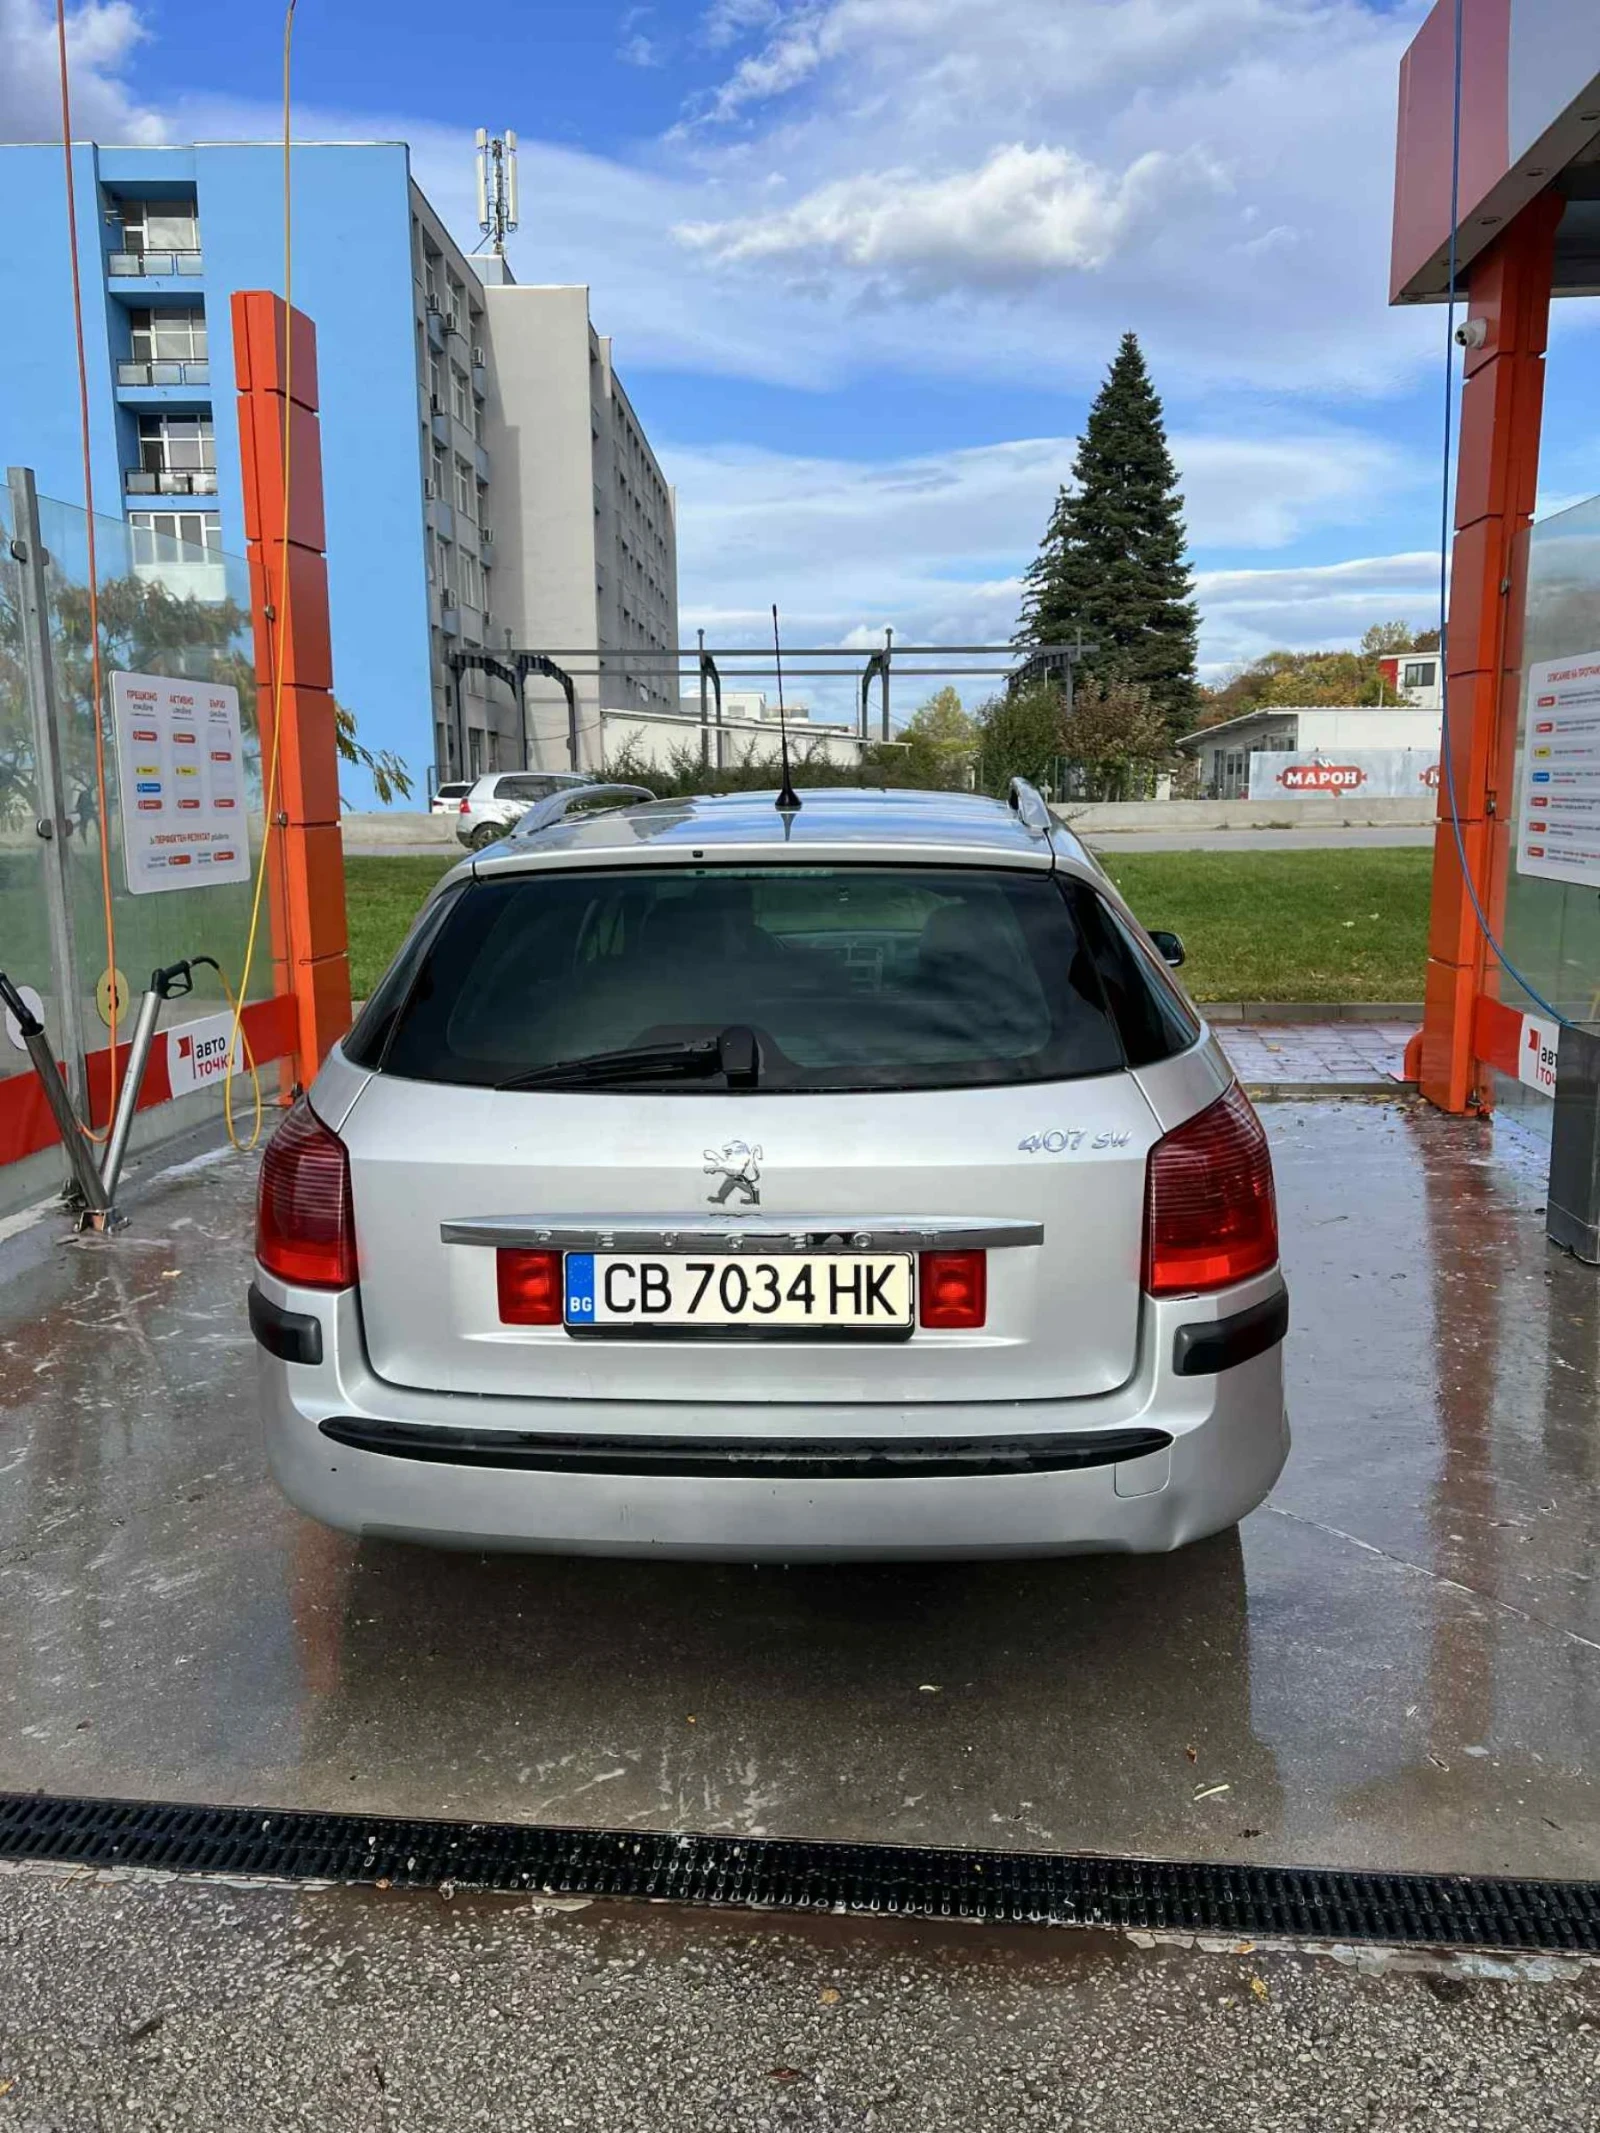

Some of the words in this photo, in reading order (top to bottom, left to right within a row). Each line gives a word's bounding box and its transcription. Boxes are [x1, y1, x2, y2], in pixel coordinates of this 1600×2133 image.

[1286, 771, 1358, 785] МАРОН
[196, 1037, 226, 1059] авто
[1541, 1047, 1558, 1069] авт
[1018, 1127, 1086, 1153] 407
[604, 1262, 672, 1313] CB
[685, 1263, 816, 1314] 7034
[828, 1263, 898, 1316] HK
[570, 1296, 593, 1312] BG
